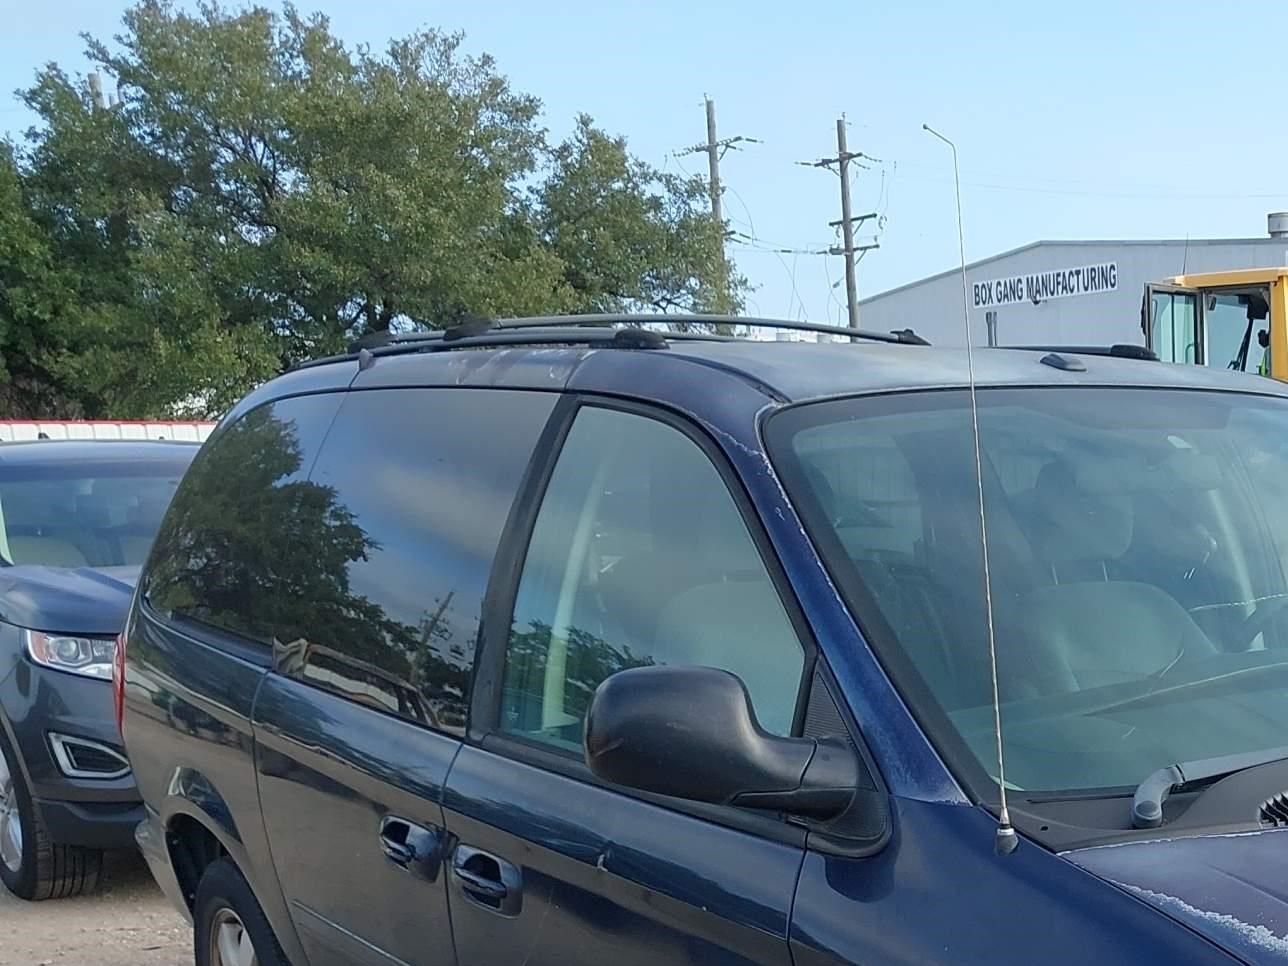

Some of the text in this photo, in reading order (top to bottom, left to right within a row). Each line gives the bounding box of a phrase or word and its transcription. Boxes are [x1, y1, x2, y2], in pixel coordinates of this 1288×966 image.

[974, 264, 1117, 306] BOX GANG MANUFACTURING
